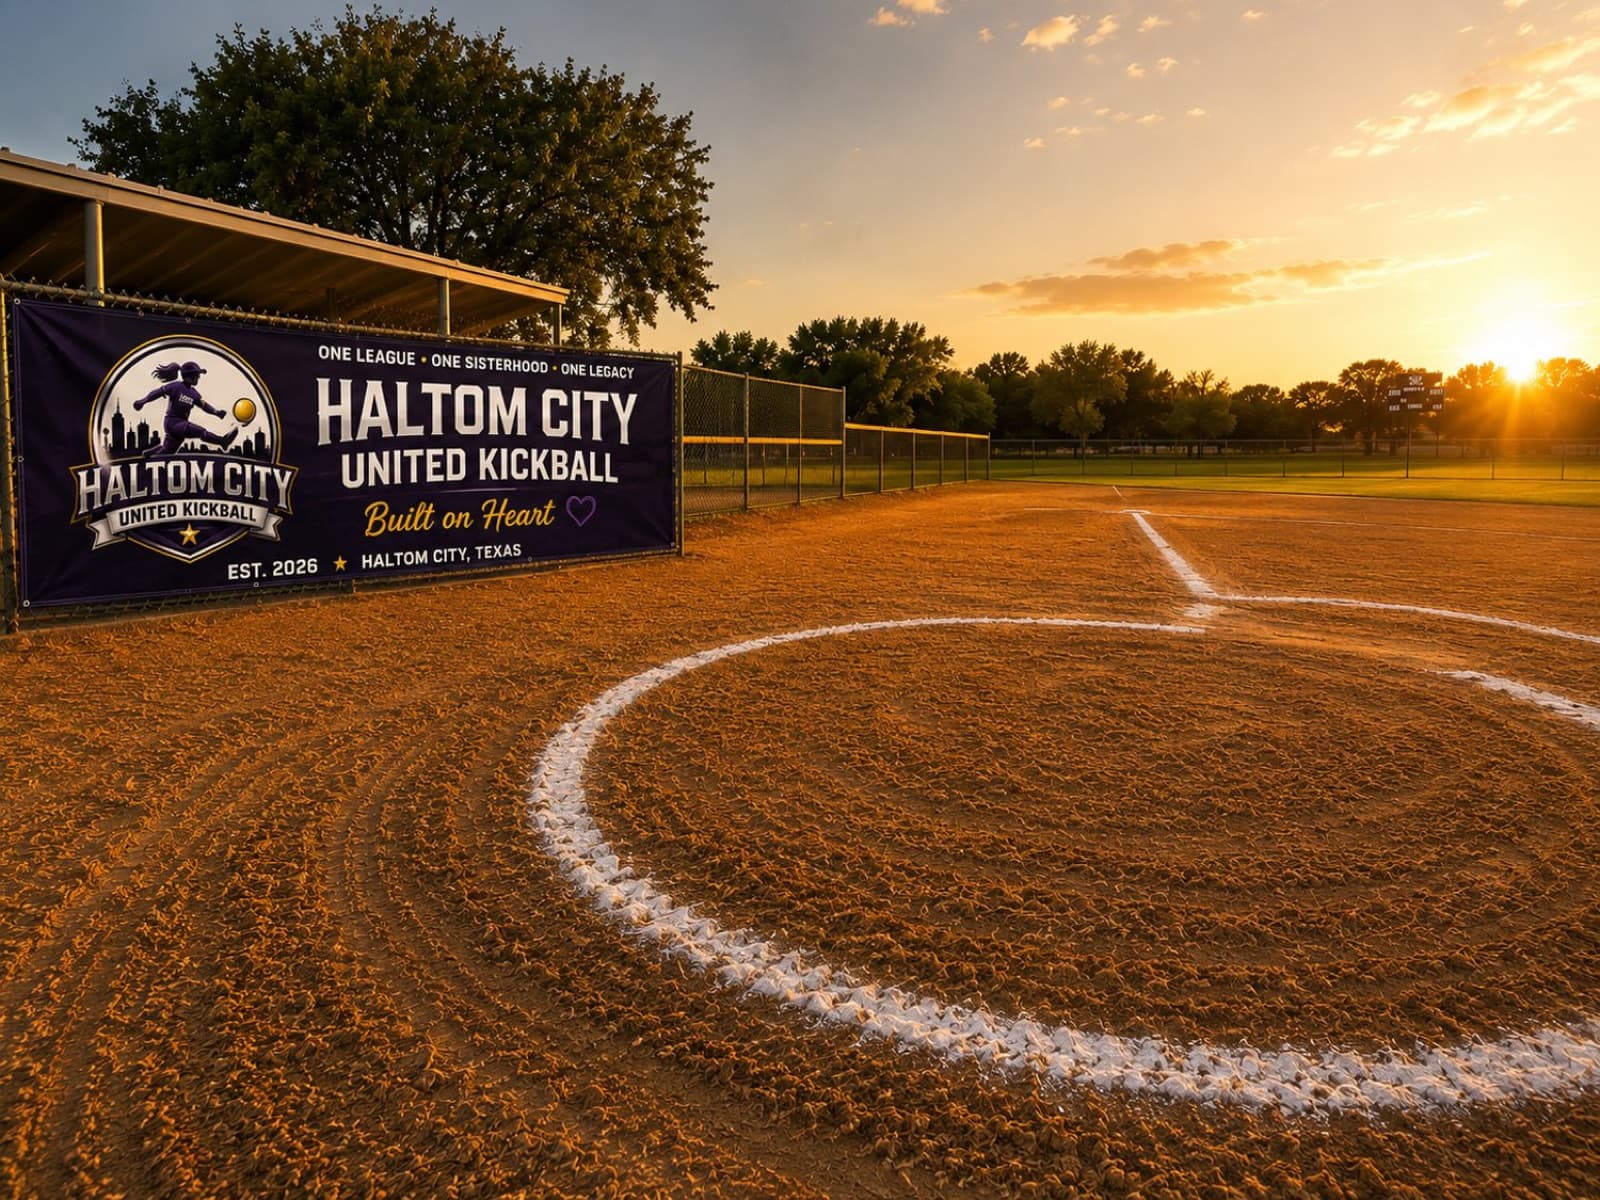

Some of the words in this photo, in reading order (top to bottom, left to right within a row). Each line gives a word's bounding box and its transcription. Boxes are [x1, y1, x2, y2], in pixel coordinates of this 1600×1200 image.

[318, 345, 351, 361] ONE
[356, 348, 416, 366] LEAGUE
[431, 353, 461, 369] ONE
[465, 355, 549, 373] SISTERHOOD
[561, 363, 587, 377] ONE
[589, 365, 635, 379] LEGACY
[316, 377, 527, 446] HALTOM
[542, 388, 638, 445] CITY
[341, 448, 466, 489] UNITED
[479, 447, 619, 484] KICKBALL
[77, 460, 216, 515] HALTOM
[223, 462, 293, 509] CITY
[119, 503, 178, 526] UNITED
[182, 501, 257, 522] KICKBALL
[364, 500, 434, 537] Built
[442, 514, 473, 529] on
[481, 498, 555, 532] Heart
[227, 563, 267, 580] EST.
[272, 558, 318, 576] 2026
[361, 550, 428, 570] HALTOM
[433, 547, 470, 564] CITY,
[475, 543, 522, 560] TEXAS
